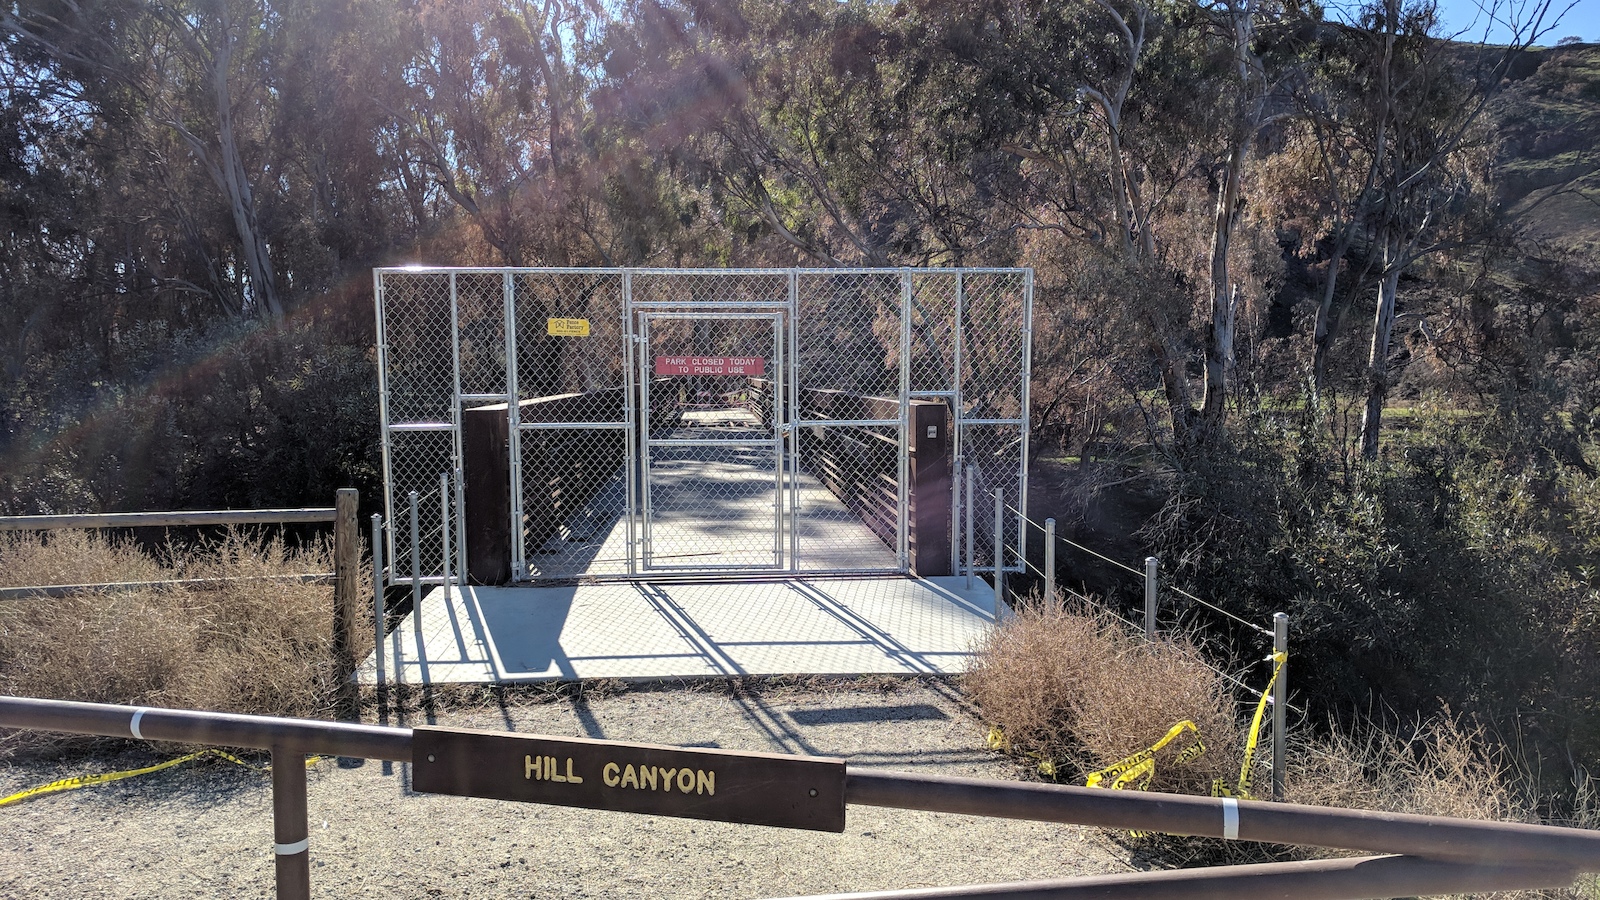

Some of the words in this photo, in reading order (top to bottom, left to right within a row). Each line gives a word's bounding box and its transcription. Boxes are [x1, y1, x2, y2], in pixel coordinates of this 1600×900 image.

[691, 358, 725, 366] CLOSED
[729, 358, 756, 366] TODAY
[678, 366, 689, 374] TO
[694, 366, 723, 374] PUBLIC
[525, 754, 583, 784] HILL
[602, 762, 715, 796] CANYON
